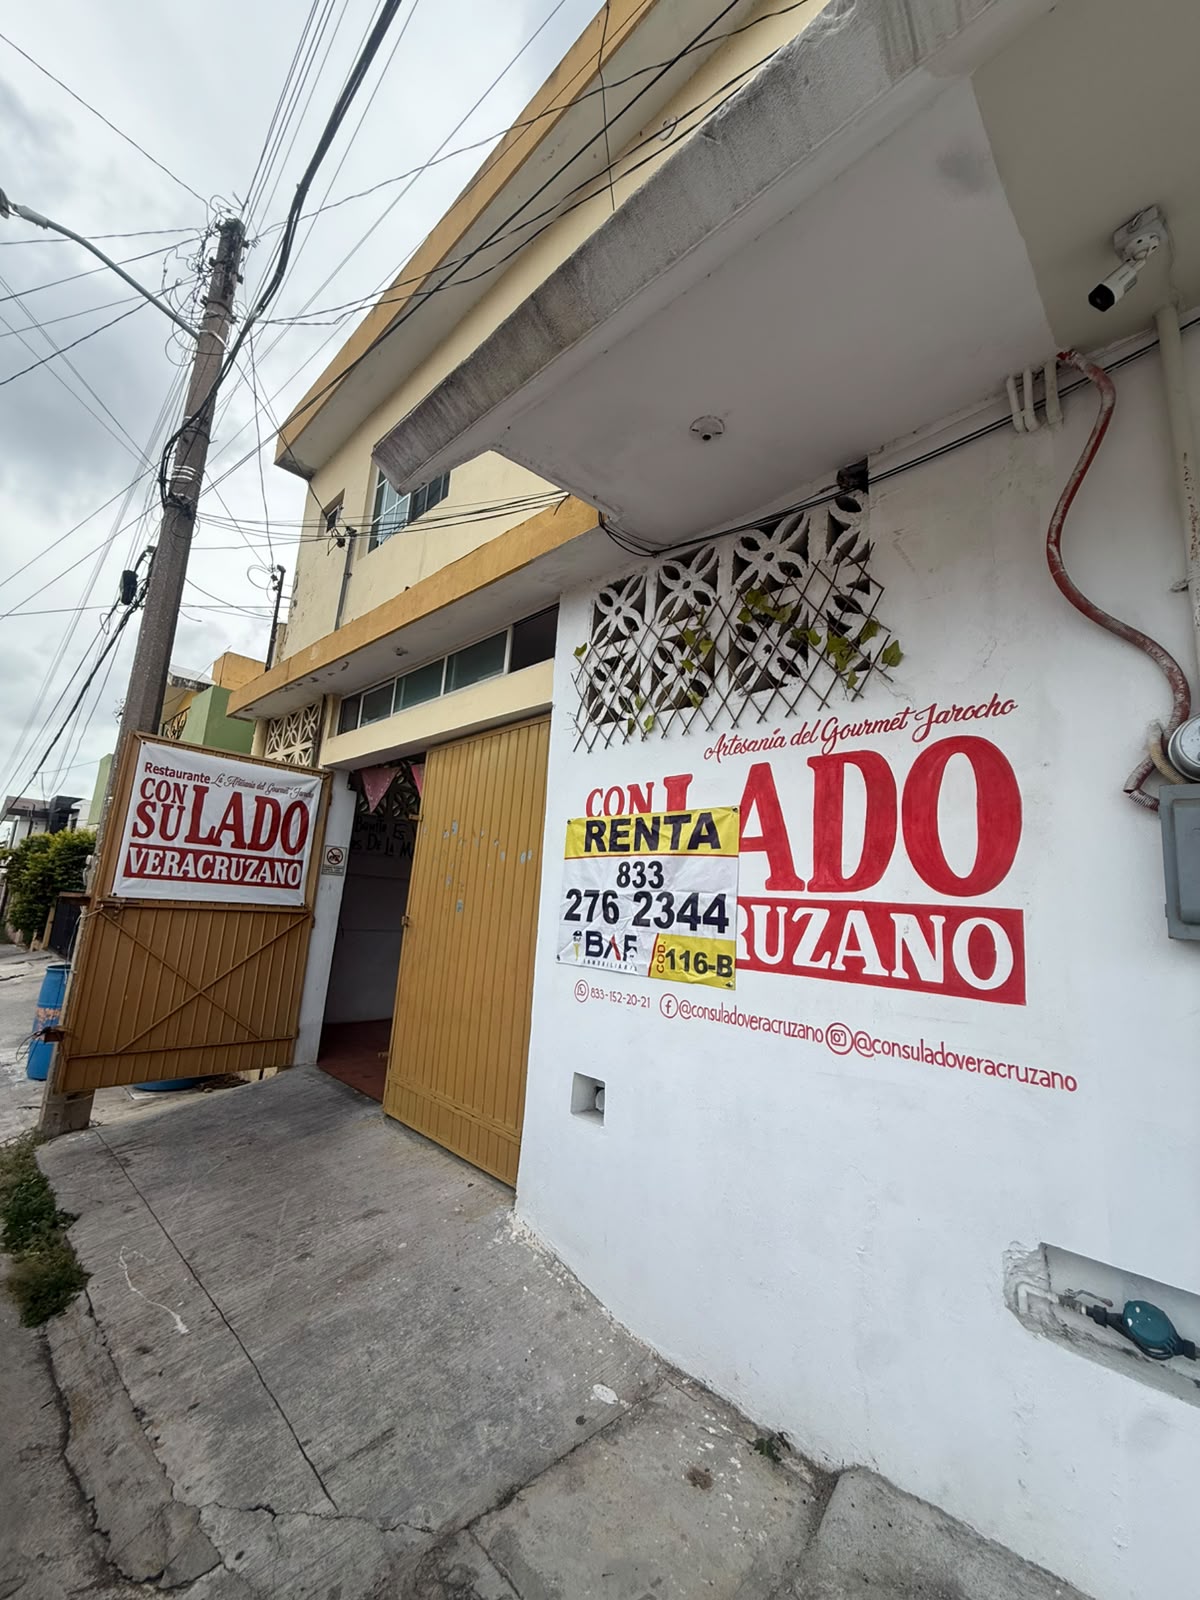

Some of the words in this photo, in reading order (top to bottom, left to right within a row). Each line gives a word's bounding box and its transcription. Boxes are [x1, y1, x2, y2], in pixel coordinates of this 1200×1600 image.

[790, 719, 822, 746] del
[820, 706, 916, 756] Gourmet
[912, 692, 1018, 743] Jarocho
[140, 777, 188, 805] CON
[144, 762, 211, 784] Restaurante
[131, 800, 186, 841] SU
[184, 784, 310, 856] LADO
[584, 812, 721, 853] RENTA
[586, 782, 655, 817] CON
[663, 735, 1023, 897] ADO
[129, 846, 302, 887] VERACRUZANO
[616, 861, 664, 889] 833
[563, 888, 620, 925] 276
[632, 890, 729, 934] 2344
[656, 940, 666, 974] COD.
[665, 948, 733, 978] 116-B
[590, 987, 650, 1008] 833-152-20-21
[679, 999, 824, 1044] @consuladoveracruzano
[854, 1030, 1078, 1092] @consuladoveracruzano
